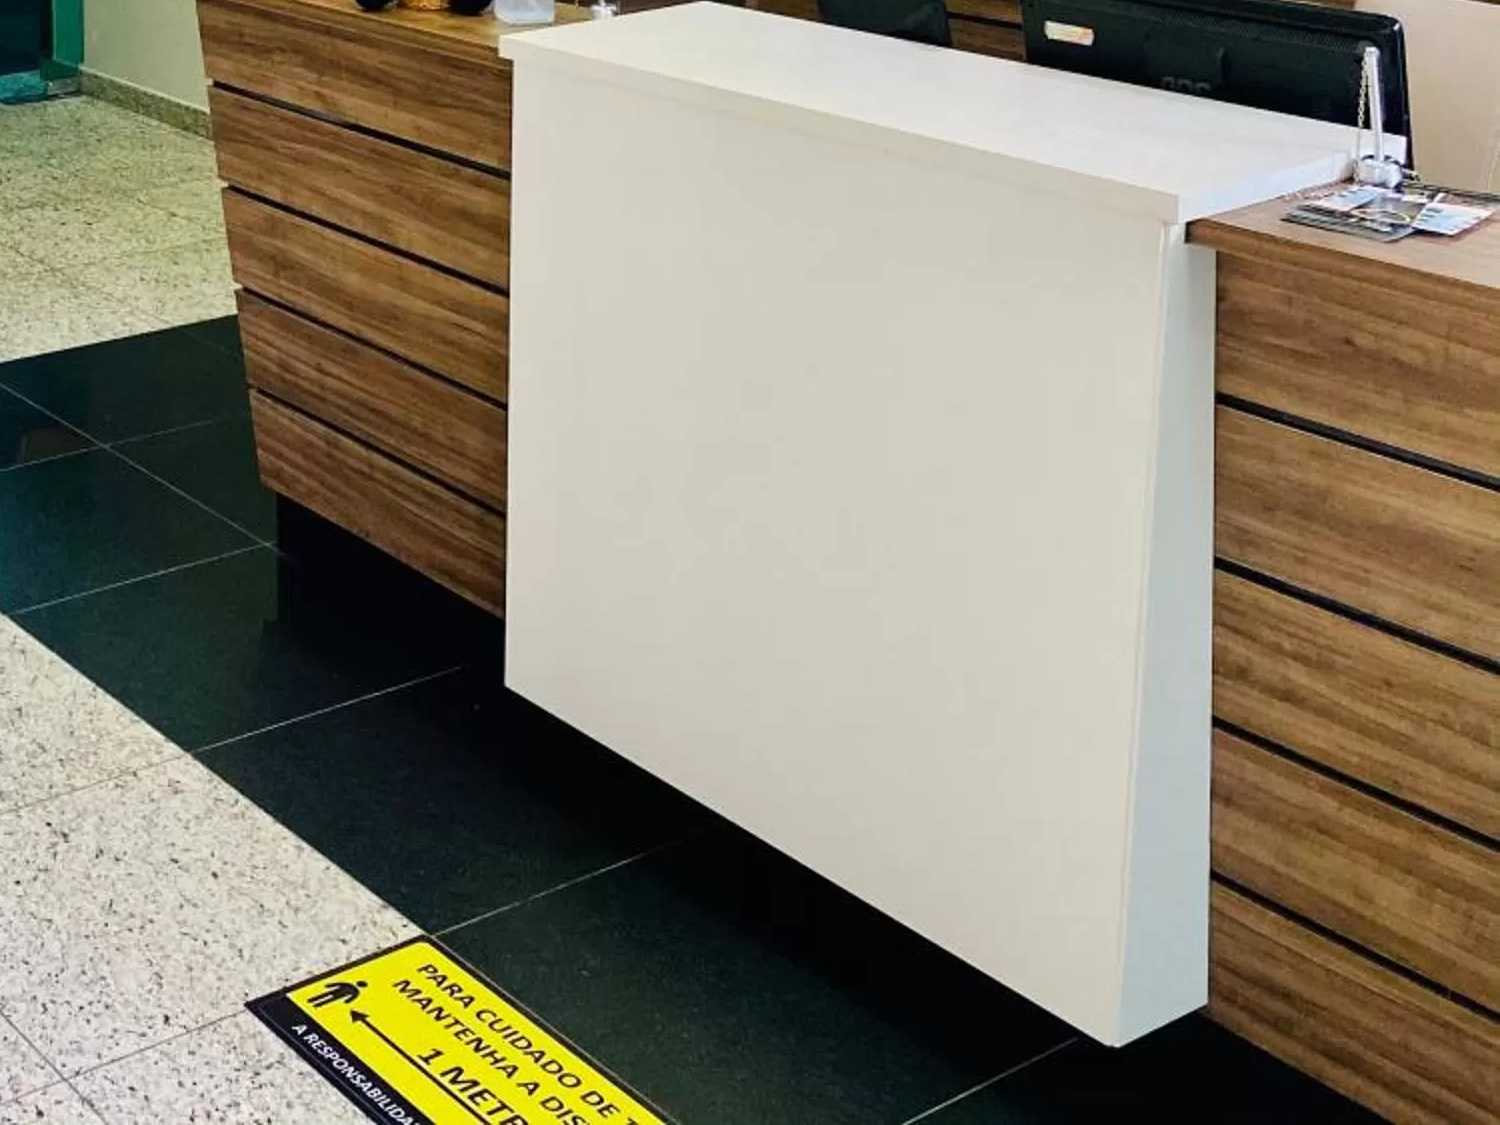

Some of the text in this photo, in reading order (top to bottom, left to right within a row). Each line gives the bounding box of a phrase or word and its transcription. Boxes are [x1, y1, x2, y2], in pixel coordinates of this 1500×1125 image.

[291, 1024, 420, 1125] A RESPONSABILIDA
[392, 979, 591, 1125] MANTENHA A DIS
[416, 963, 621, 1118] PARA CUIDADO DE
[416, 1047, 445, 1065] 1
